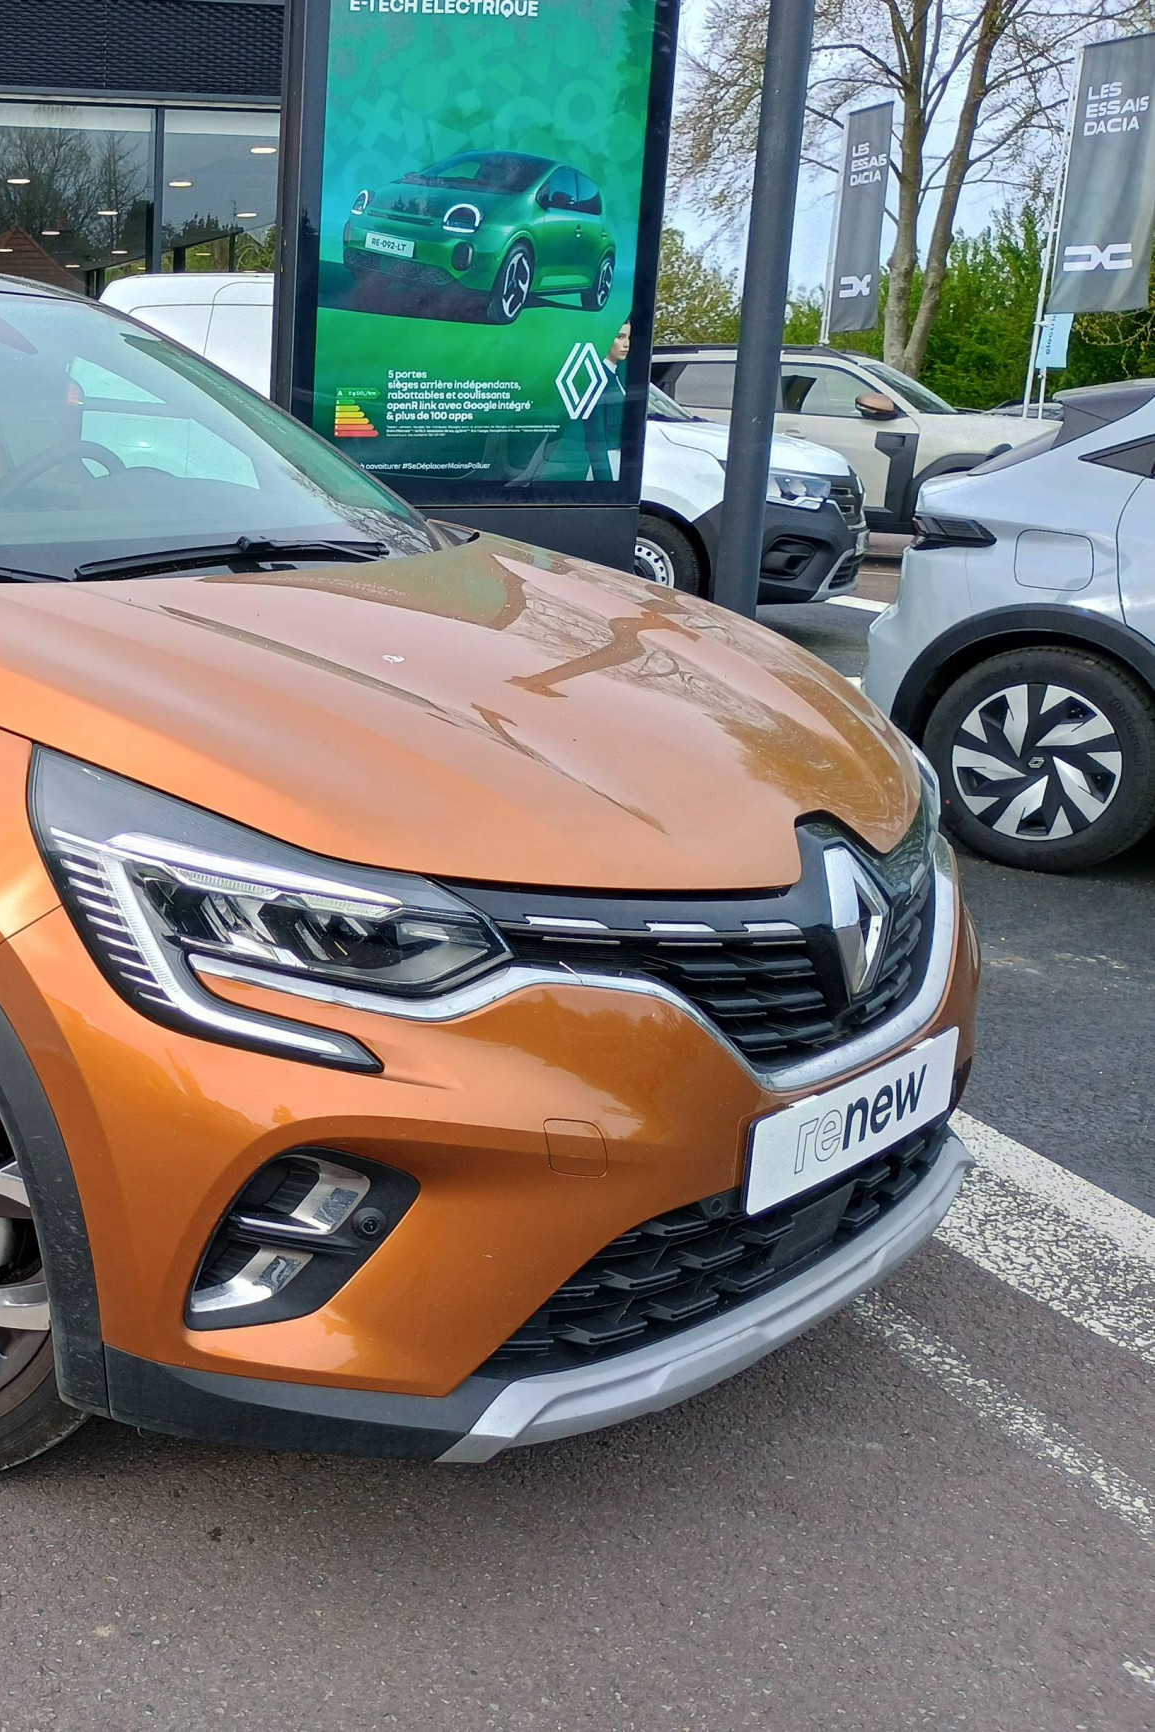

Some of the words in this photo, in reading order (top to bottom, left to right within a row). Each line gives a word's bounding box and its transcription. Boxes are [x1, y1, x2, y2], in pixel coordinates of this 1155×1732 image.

[349, 0, 418, 13] E-TECH
[1087, 81, 1123, 101] LES
[1085, 96, 1150, 119] ESSAIS
[1083, 115, 1140, 137] DACIA
[852, 142, 870, 158] LES
[850, 153, 887, 173] ESSAIS
[850, 169, 882, 187] DACIA
[371, 237, 407, 252] RE-092-LT
[388, 370, 394, 379] 5
[395, 370, 428, 382] portes
[387, 380, 419, 392] sièges
[420, 380, 453, 390] arrière
[454, 380, 521, 391] indépendants,
[387, 390, 445, 400] rabattables
[446, 390, 457, 400] et
[457, 390, 511, 400] coulissants
[387, 401, 418, 412] openR
[419, 401, 437, 410] link
[438, 402, 462, 411] avec
[463, 401, 497, 412] Google
[386, 411, 394, 421] &
[395, 411, 416, 422] plus
[417, 411, 430, 421] de
[430, 411, 448, 421] 100
[448, 412, 474, 423] apps
[793, 1063, 928, 1175] renew
